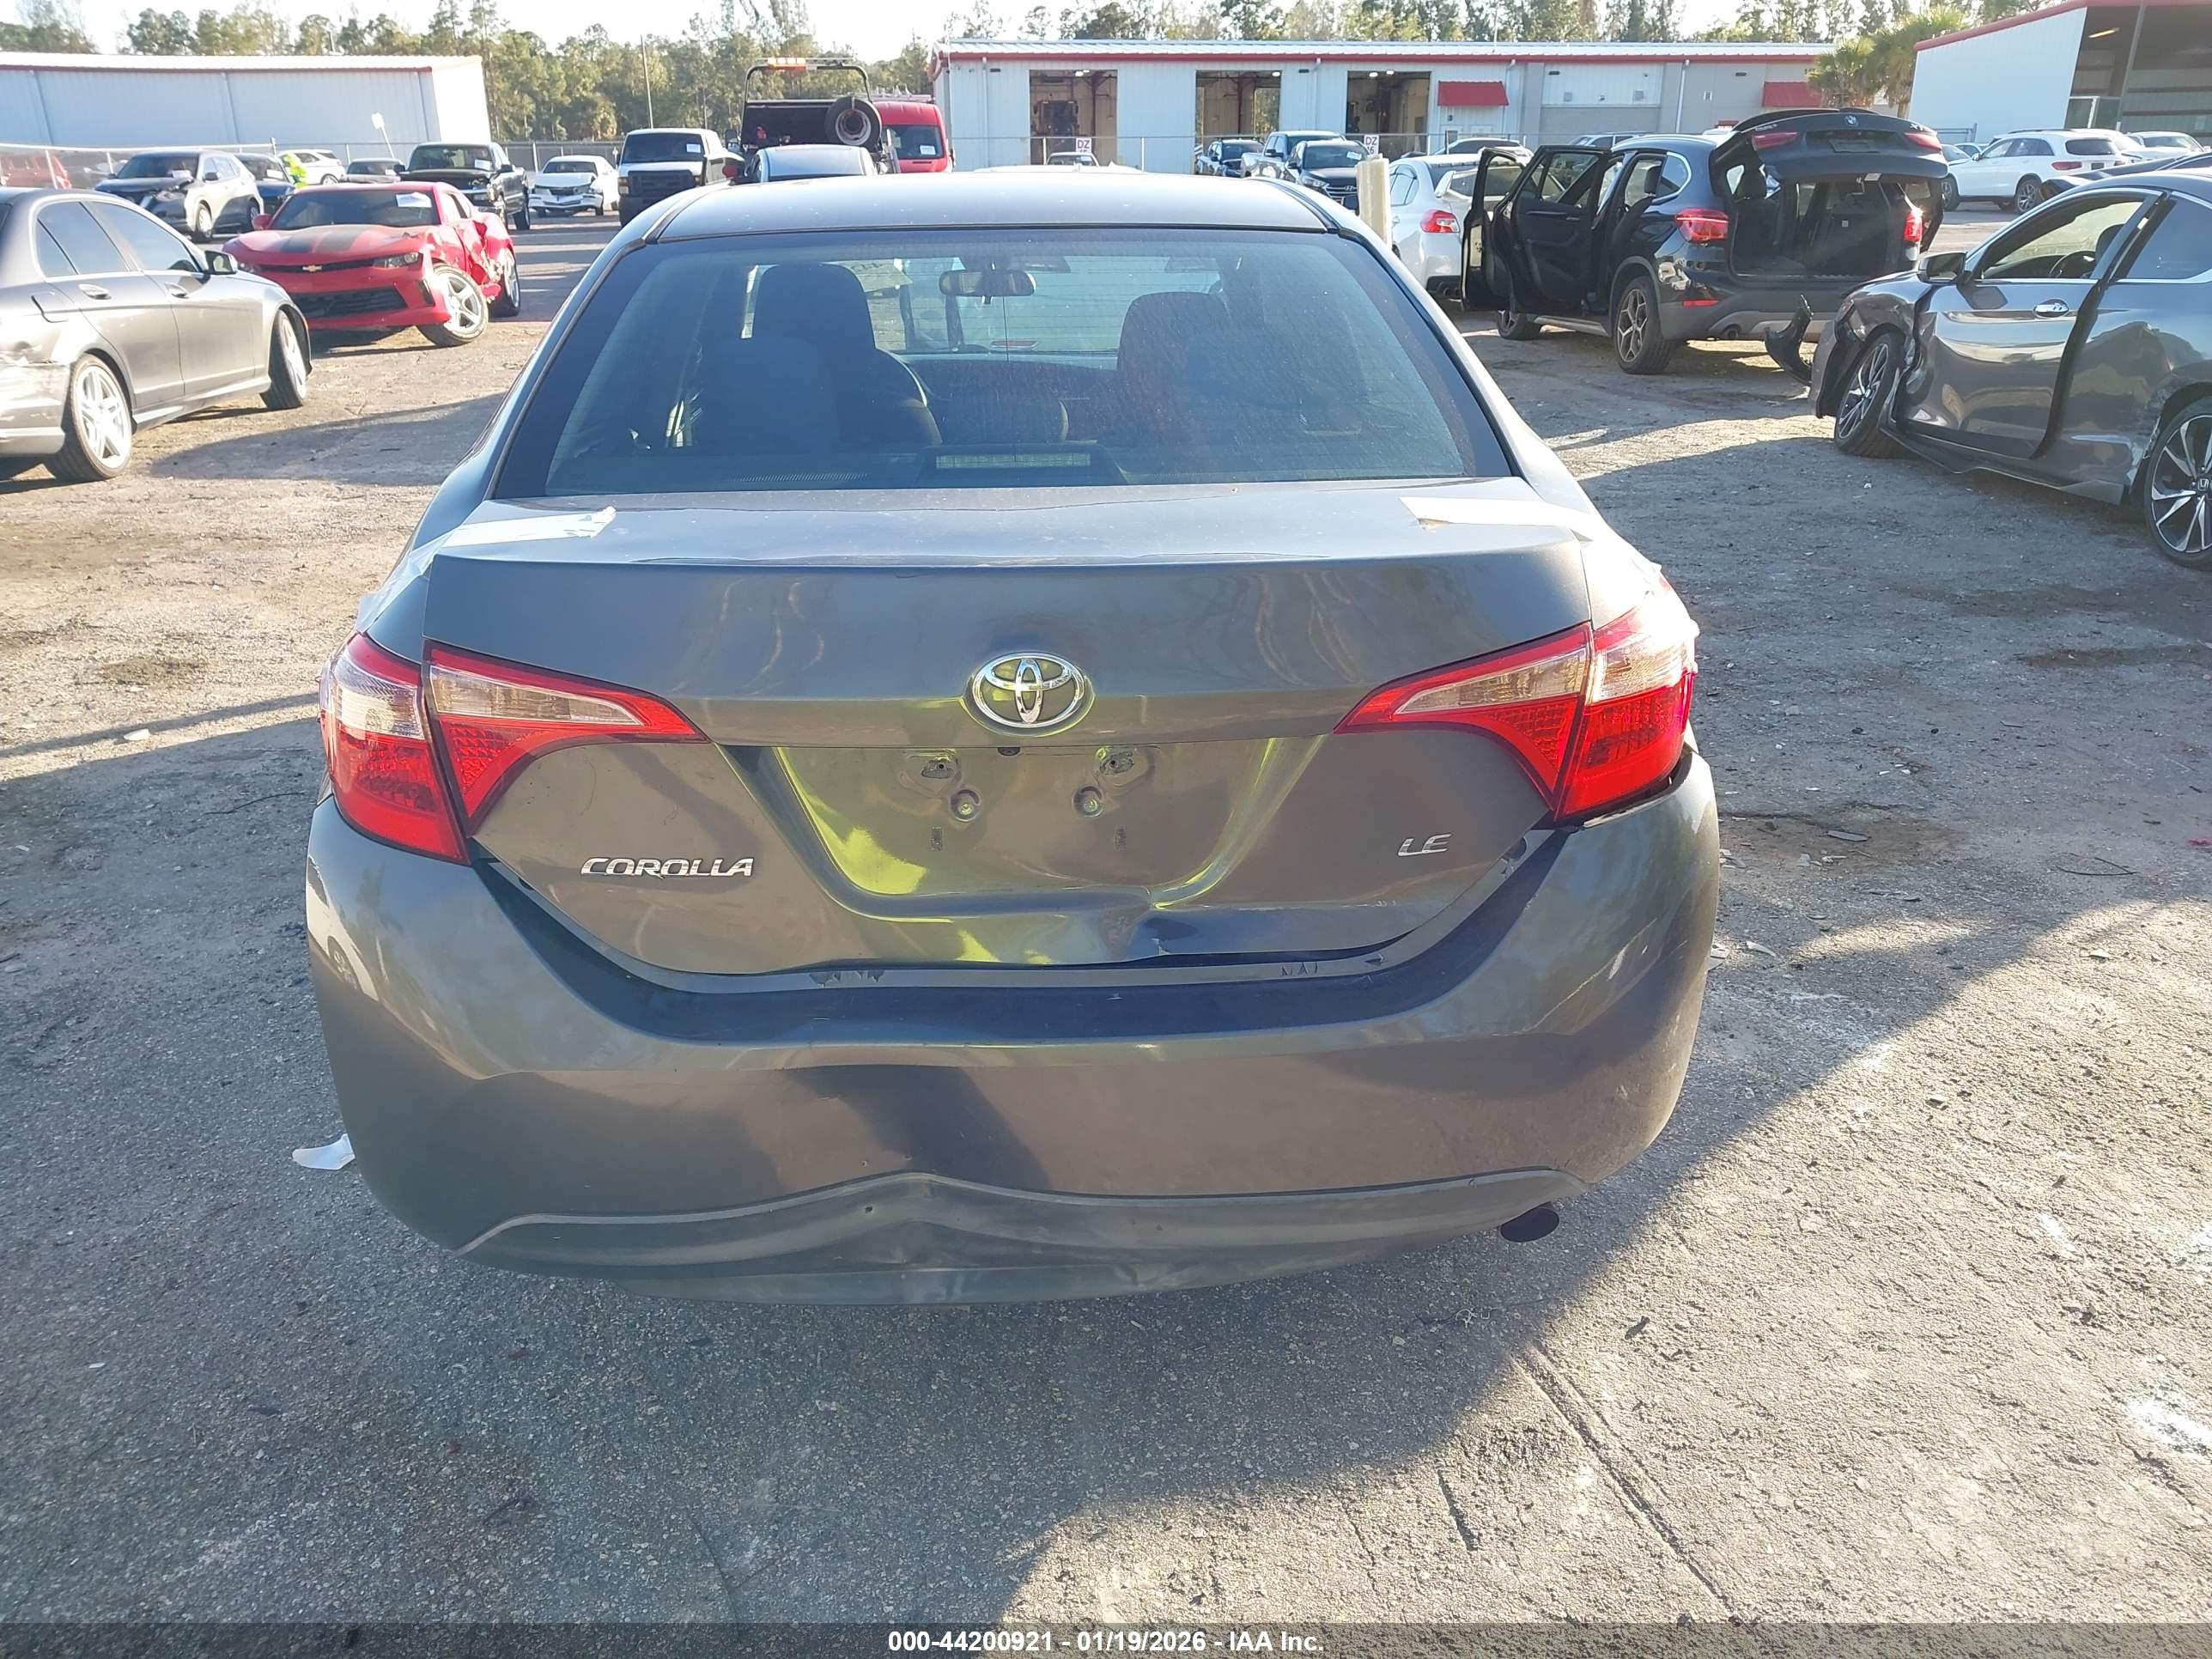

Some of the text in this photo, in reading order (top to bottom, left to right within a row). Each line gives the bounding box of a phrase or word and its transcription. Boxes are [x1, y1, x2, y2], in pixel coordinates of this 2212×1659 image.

[1077, 139, 1091, 149] DZ
[1365, 137, 1377, 145] DZ
[1398, 834, 1452, 857] LE
[580, 857, 754, 879] COROLLA
